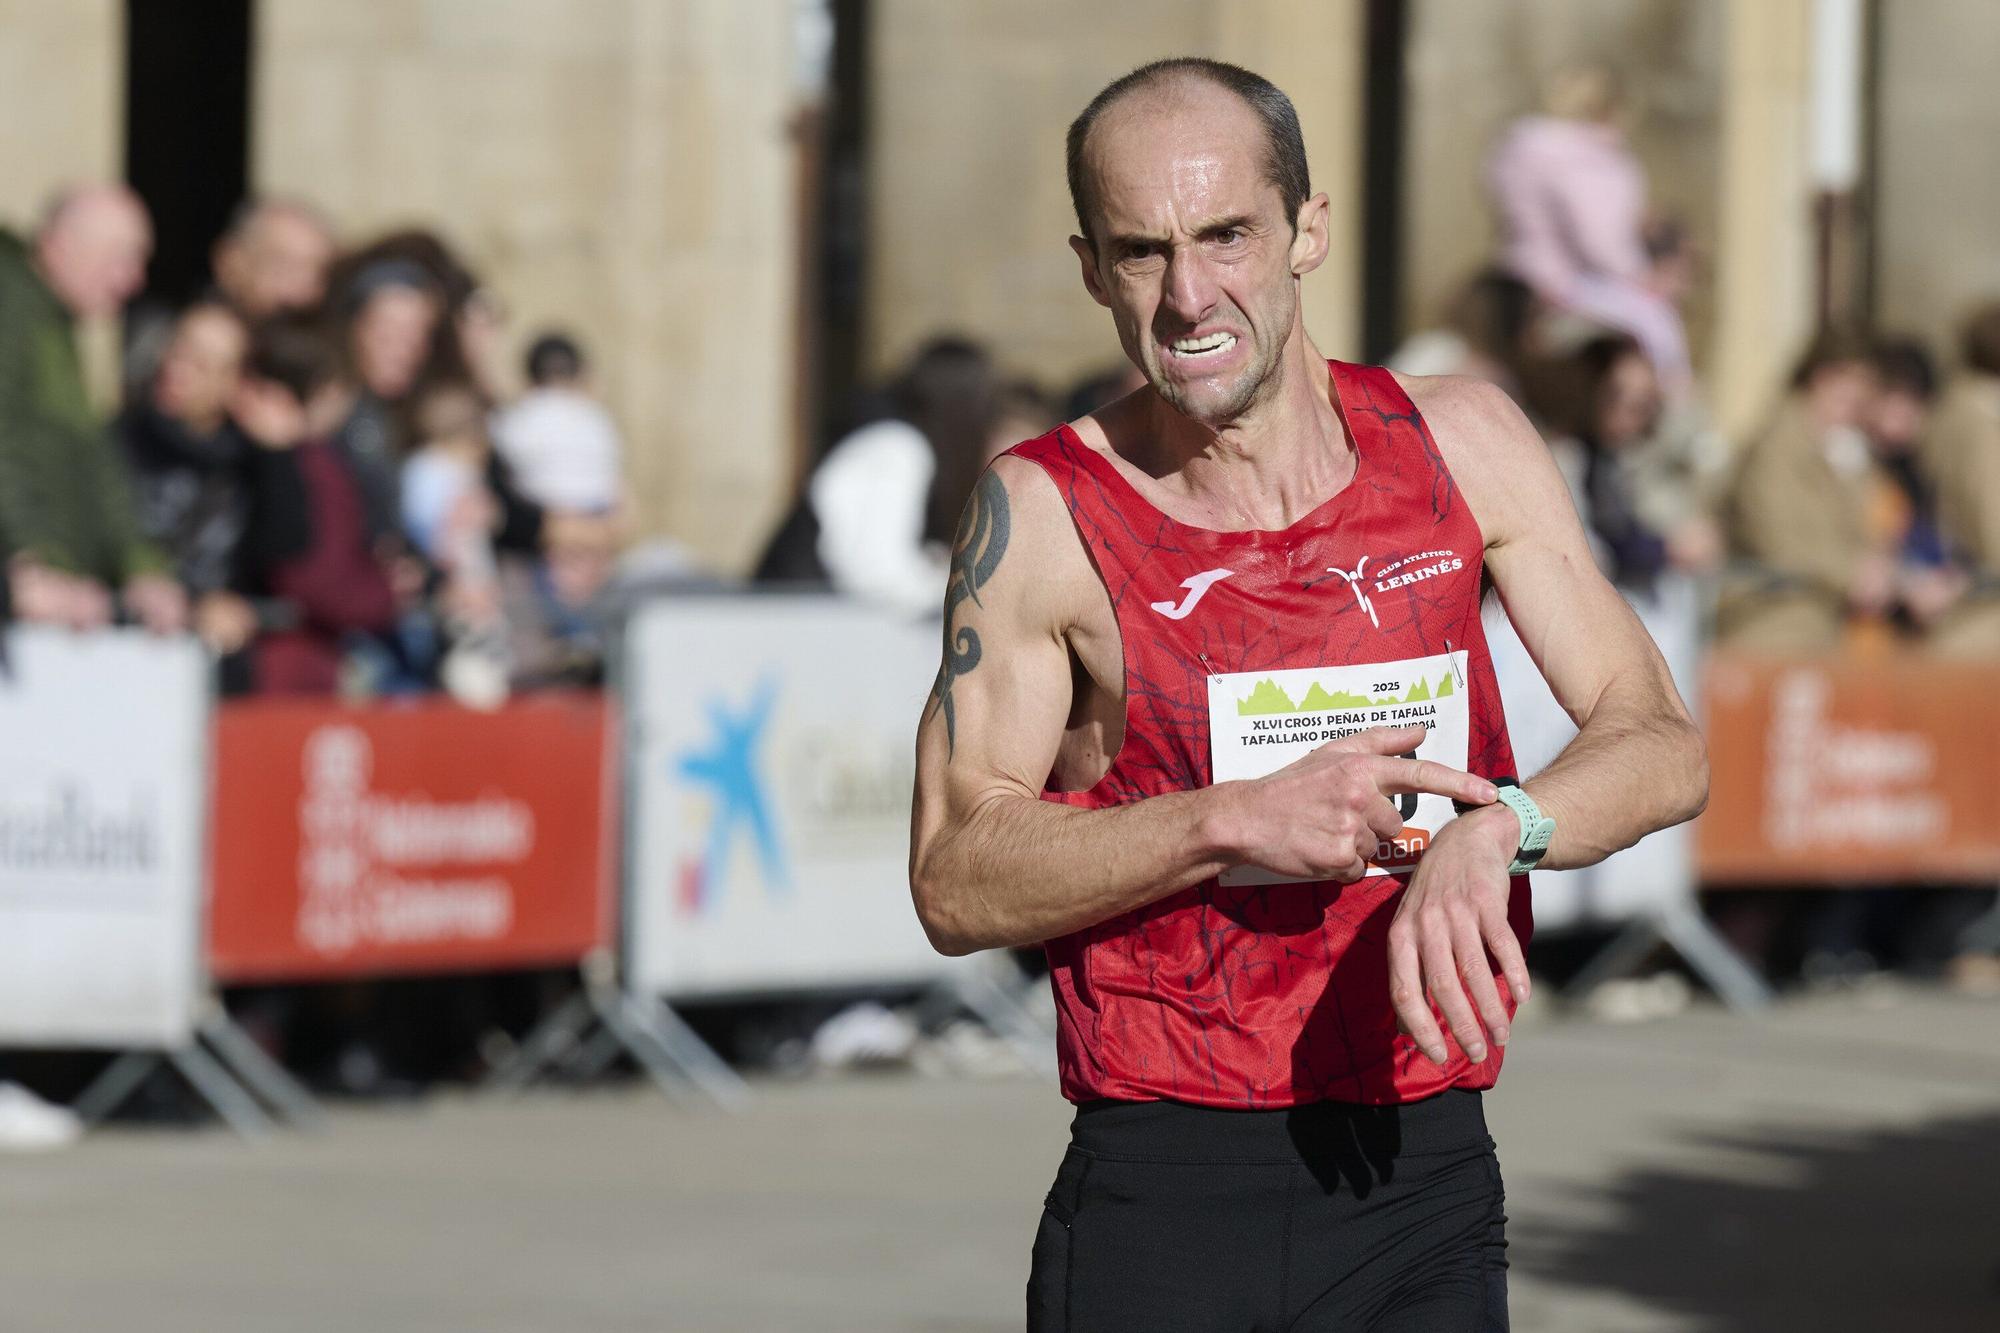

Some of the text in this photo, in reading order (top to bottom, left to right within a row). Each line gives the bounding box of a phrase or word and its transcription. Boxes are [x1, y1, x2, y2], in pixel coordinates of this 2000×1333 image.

[1375, 558, 1463, 592] LERINÉS
[1377, 561, 1401, 578] CLUB
[1373, 681, 1400, 692] 2025
[1253, 704, 1437, 730] XLVI CROSS PEÑAS DE TAFALLA
[1241, 731, 1318, 746] TAFALLAKO
